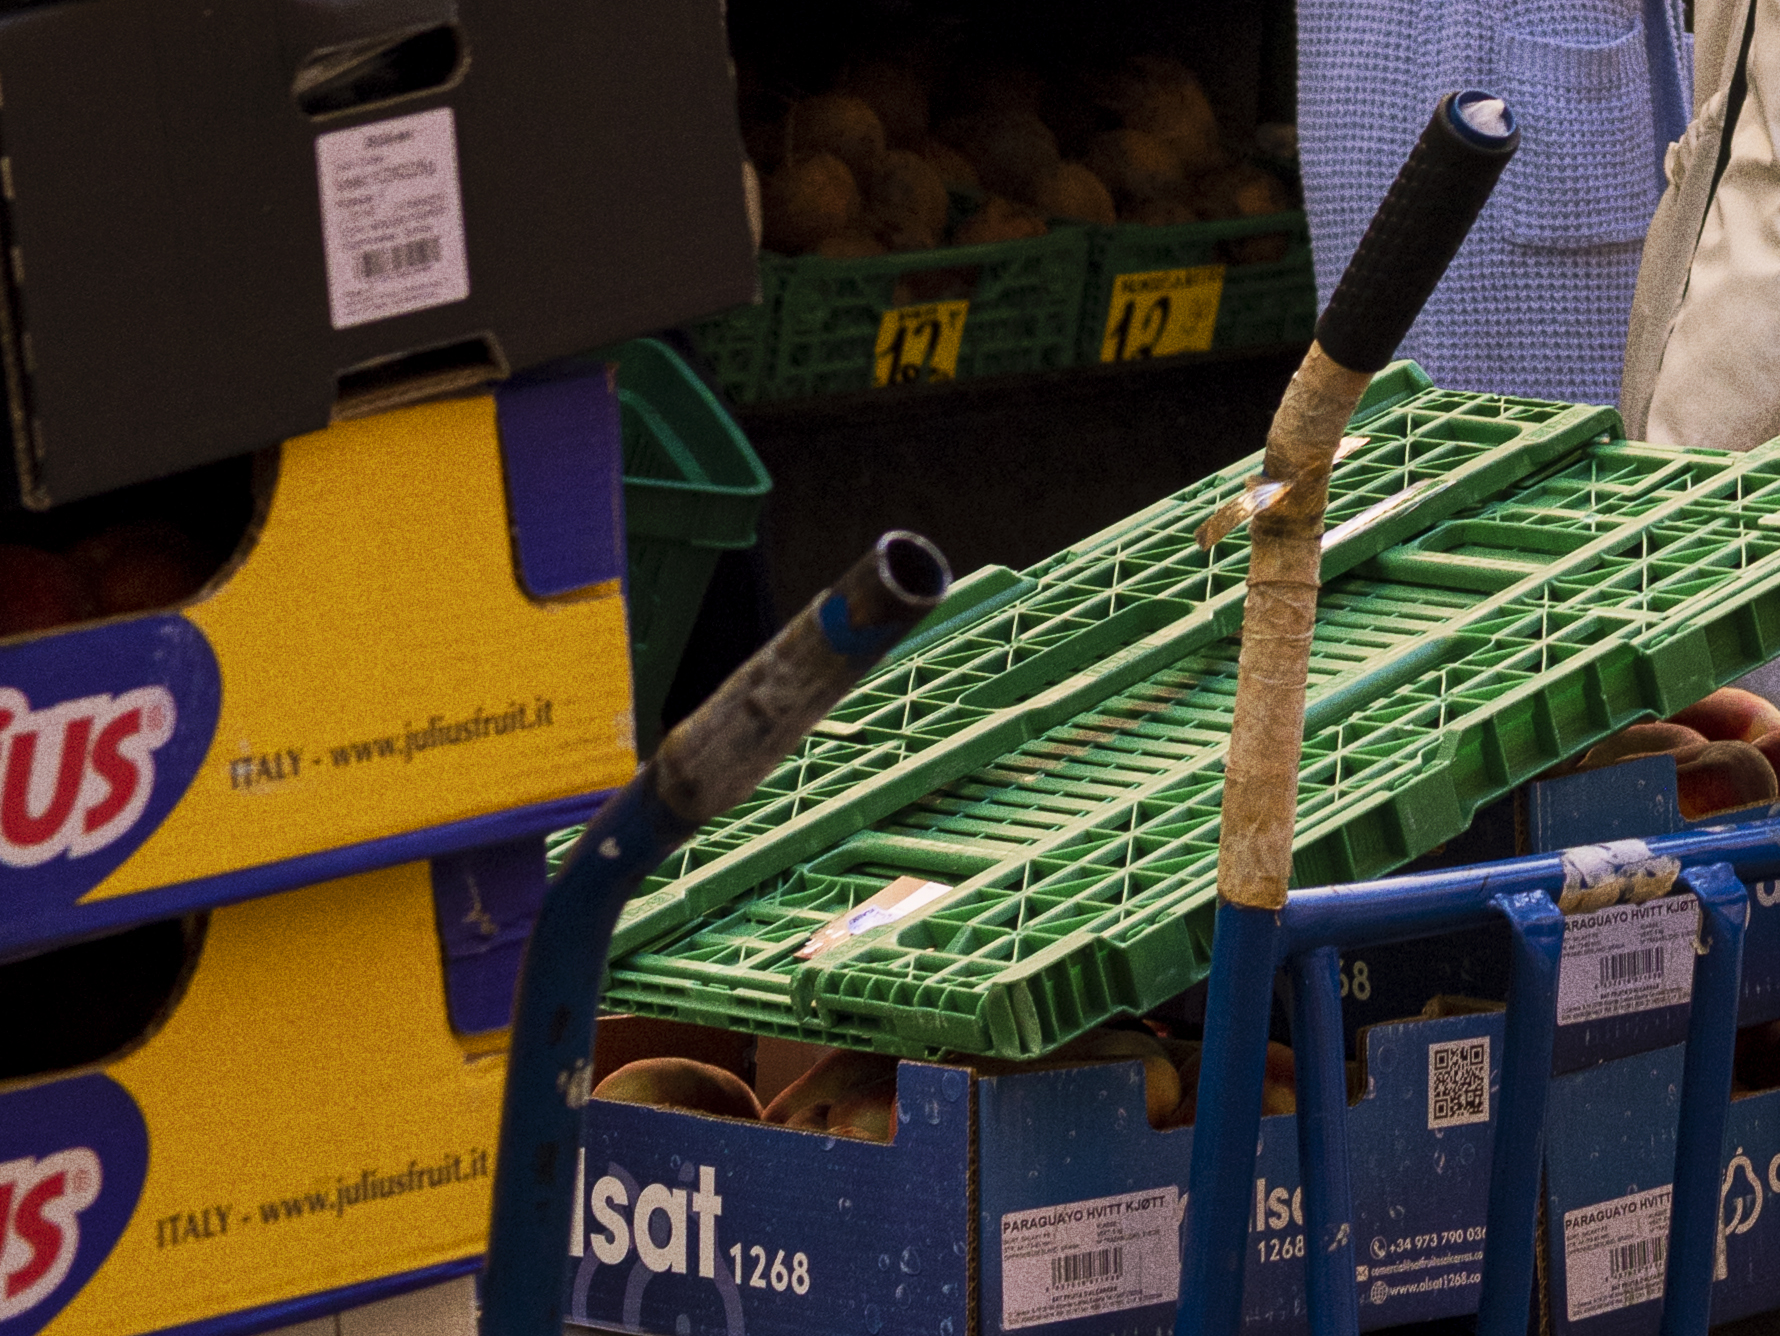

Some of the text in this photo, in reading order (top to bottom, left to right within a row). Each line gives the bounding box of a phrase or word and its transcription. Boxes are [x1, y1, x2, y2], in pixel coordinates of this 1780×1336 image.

[229, 749, 304, 791] ITALY
[329, 697, 554, 769] www.juliusfruit.it
[1631, 904, 1663, 921] HVITT
[156, 1203, 232, 1250] ITALY
[258, 1147, 489, 1225] www.juliusfruit.it
[1003, 1195, 1166, 1233] PARAGUAYO HVITT KJØTT
[1565, 1201, 1638, 1230] PARAGUAYO
[1415, 1232, 1438, 1249] 973
[1441, 1228, 1463, 1246] 790
[728, 1241, 811, 1296] 1268
